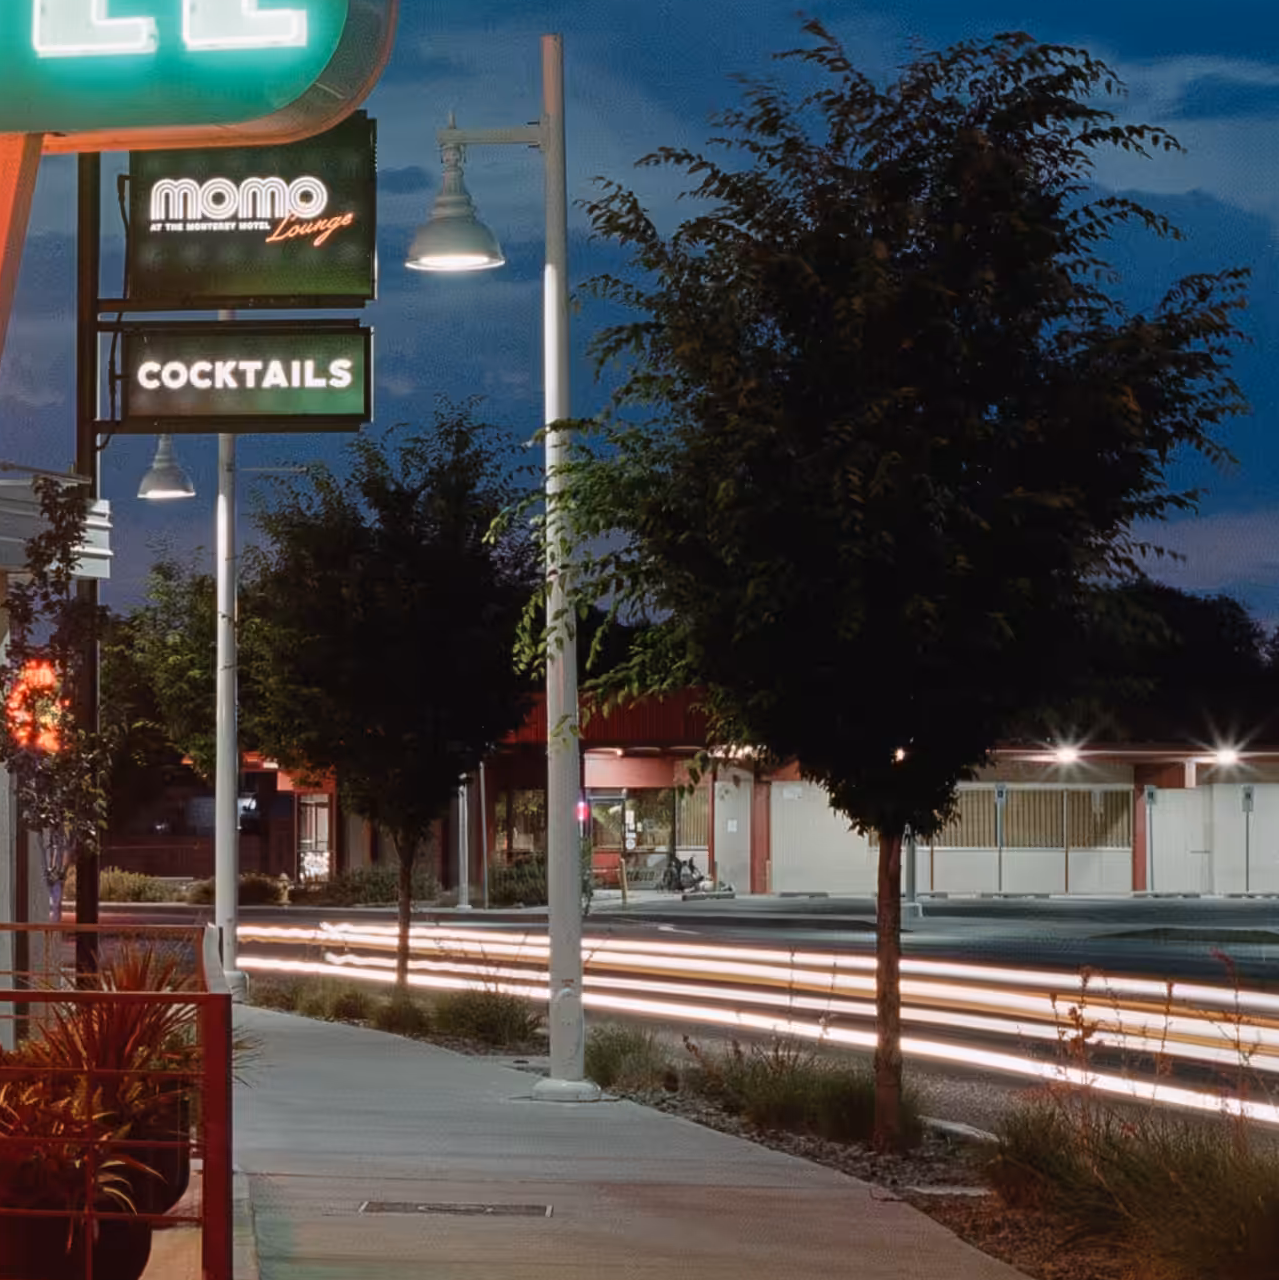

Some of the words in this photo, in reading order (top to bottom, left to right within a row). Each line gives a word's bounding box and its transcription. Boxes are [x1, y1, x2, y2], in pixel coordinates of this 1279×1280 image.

[150, 223, 163, 232] AT
[166, 222, 183, 231] THE
[186, 222, 236, 231] MONTEREY
[239, 221, 271, 231] MOTEL
[265, 210, 355, 247] Lounge
[137, 359, 353, 391] COCKTAILS
